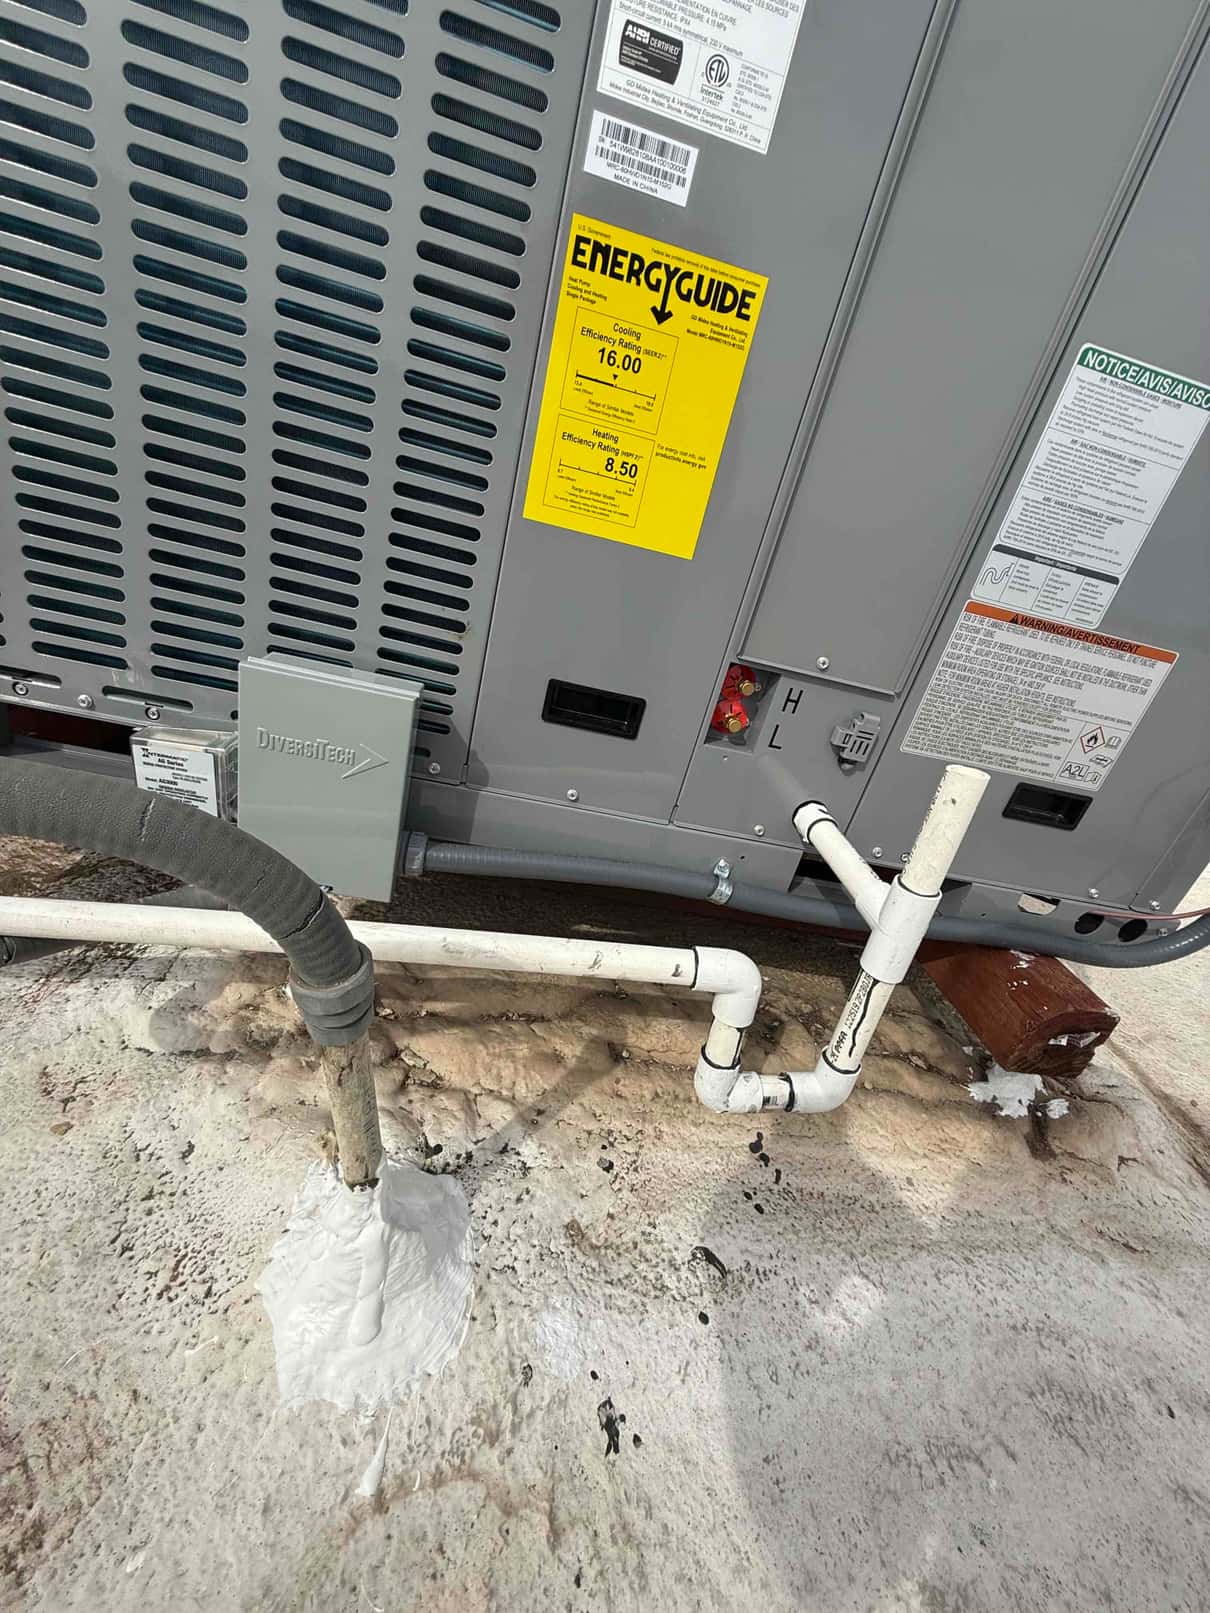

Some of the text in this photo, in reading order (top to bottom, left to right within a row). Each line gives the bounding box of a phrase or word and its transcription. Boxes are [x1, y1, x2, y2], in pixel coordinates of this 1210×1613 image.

[700, 86, 723, 101] Intertek
[570, 232, 757, 322] ENERGYGUIDE
[580, 325, 617, 347] Efficiency
[617, 337, 642, 354] Rating
[612, 322, 641, 341] Cooling
[596, 345, 642, 375] 16.00
[560, 431, 596, 450] Efficiency
[596, 441, 620, 457] Rating
[591, 427, 619, 444] Heating
[603, 455, 639, 480] 8.50
[1018, 615, 1141, 653] WARNING/AVERTISSEMENT
[781, 687, 803, 714] H
[768, 724, 782, 750] L
[1062, 763, 1084, 778] A2L
